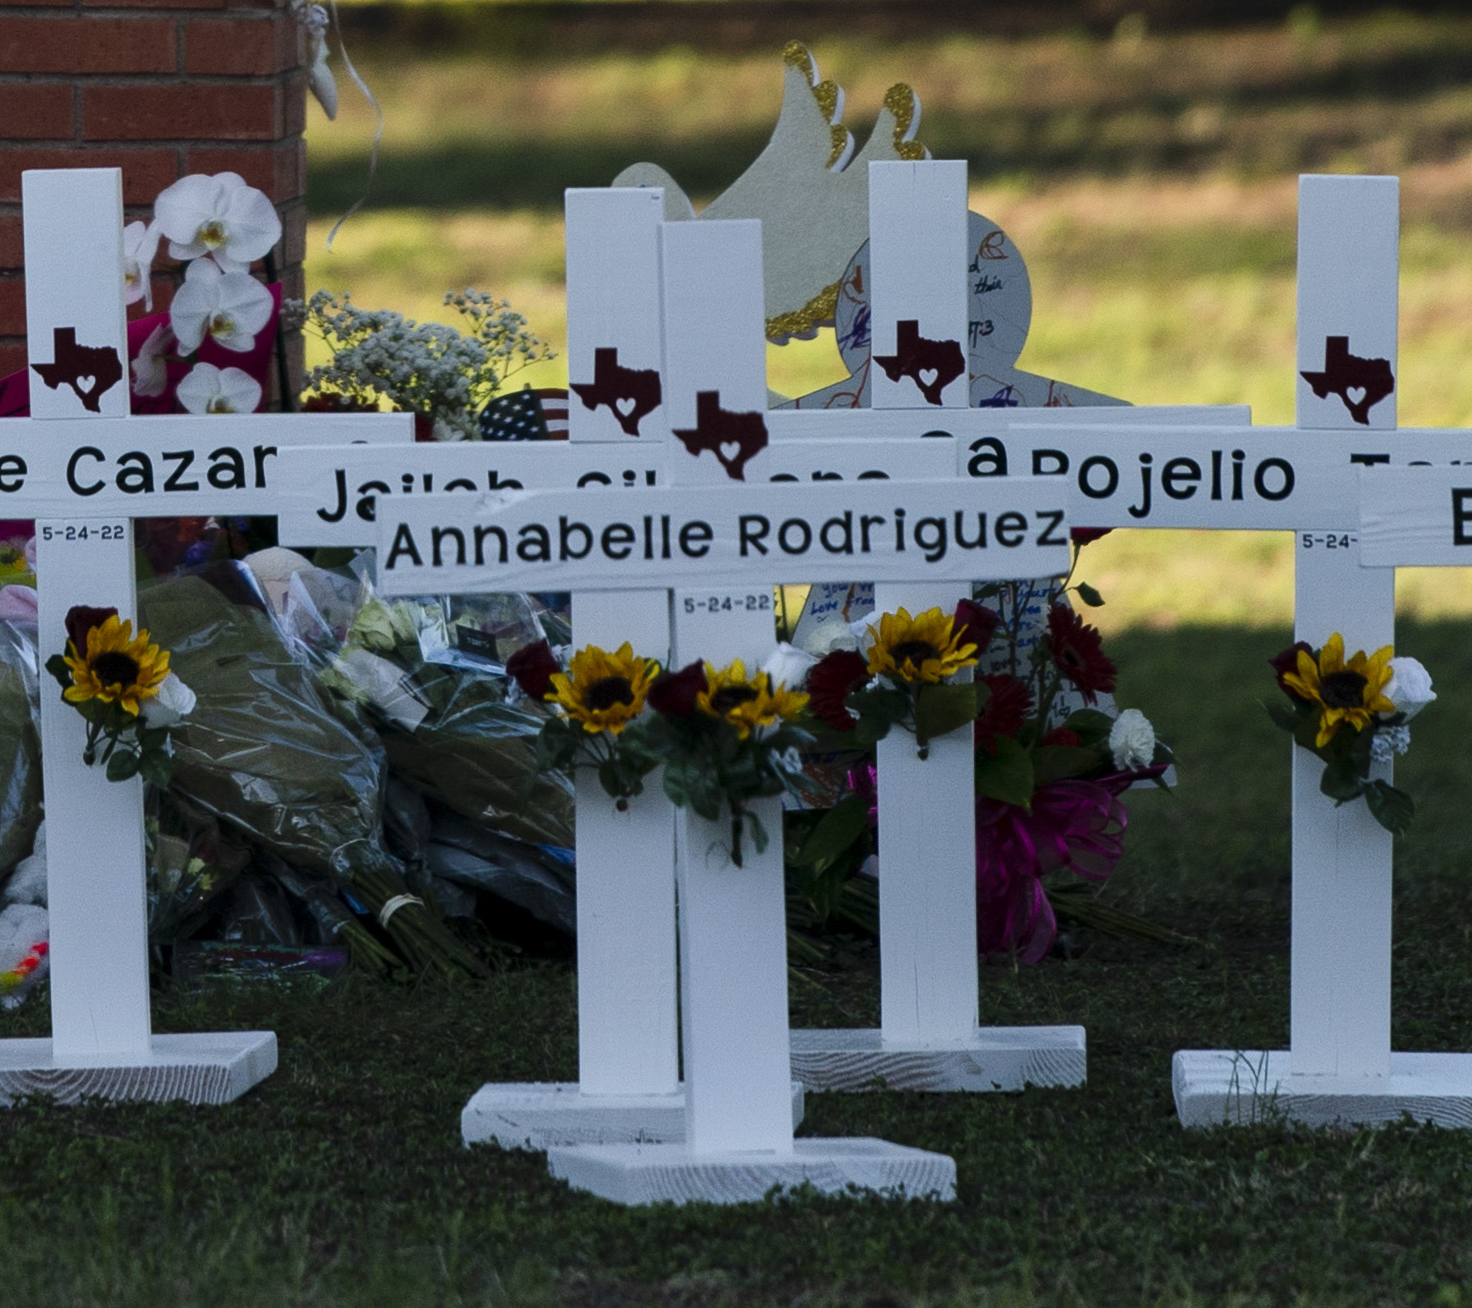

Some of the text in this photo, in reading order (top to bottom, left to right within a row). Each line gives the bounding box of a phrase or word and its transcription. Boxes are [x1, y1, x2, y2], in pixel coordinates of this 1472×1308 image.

[66, 445, 278, 496] Cazar
[42, 525, 125, 542] 5-24-22
[384, 506, 1067, 572] Annabelle Rodriguez
[1302, 533, 1358, 549] 5-24-
[682, 594, 772, 615] 5-24-22
